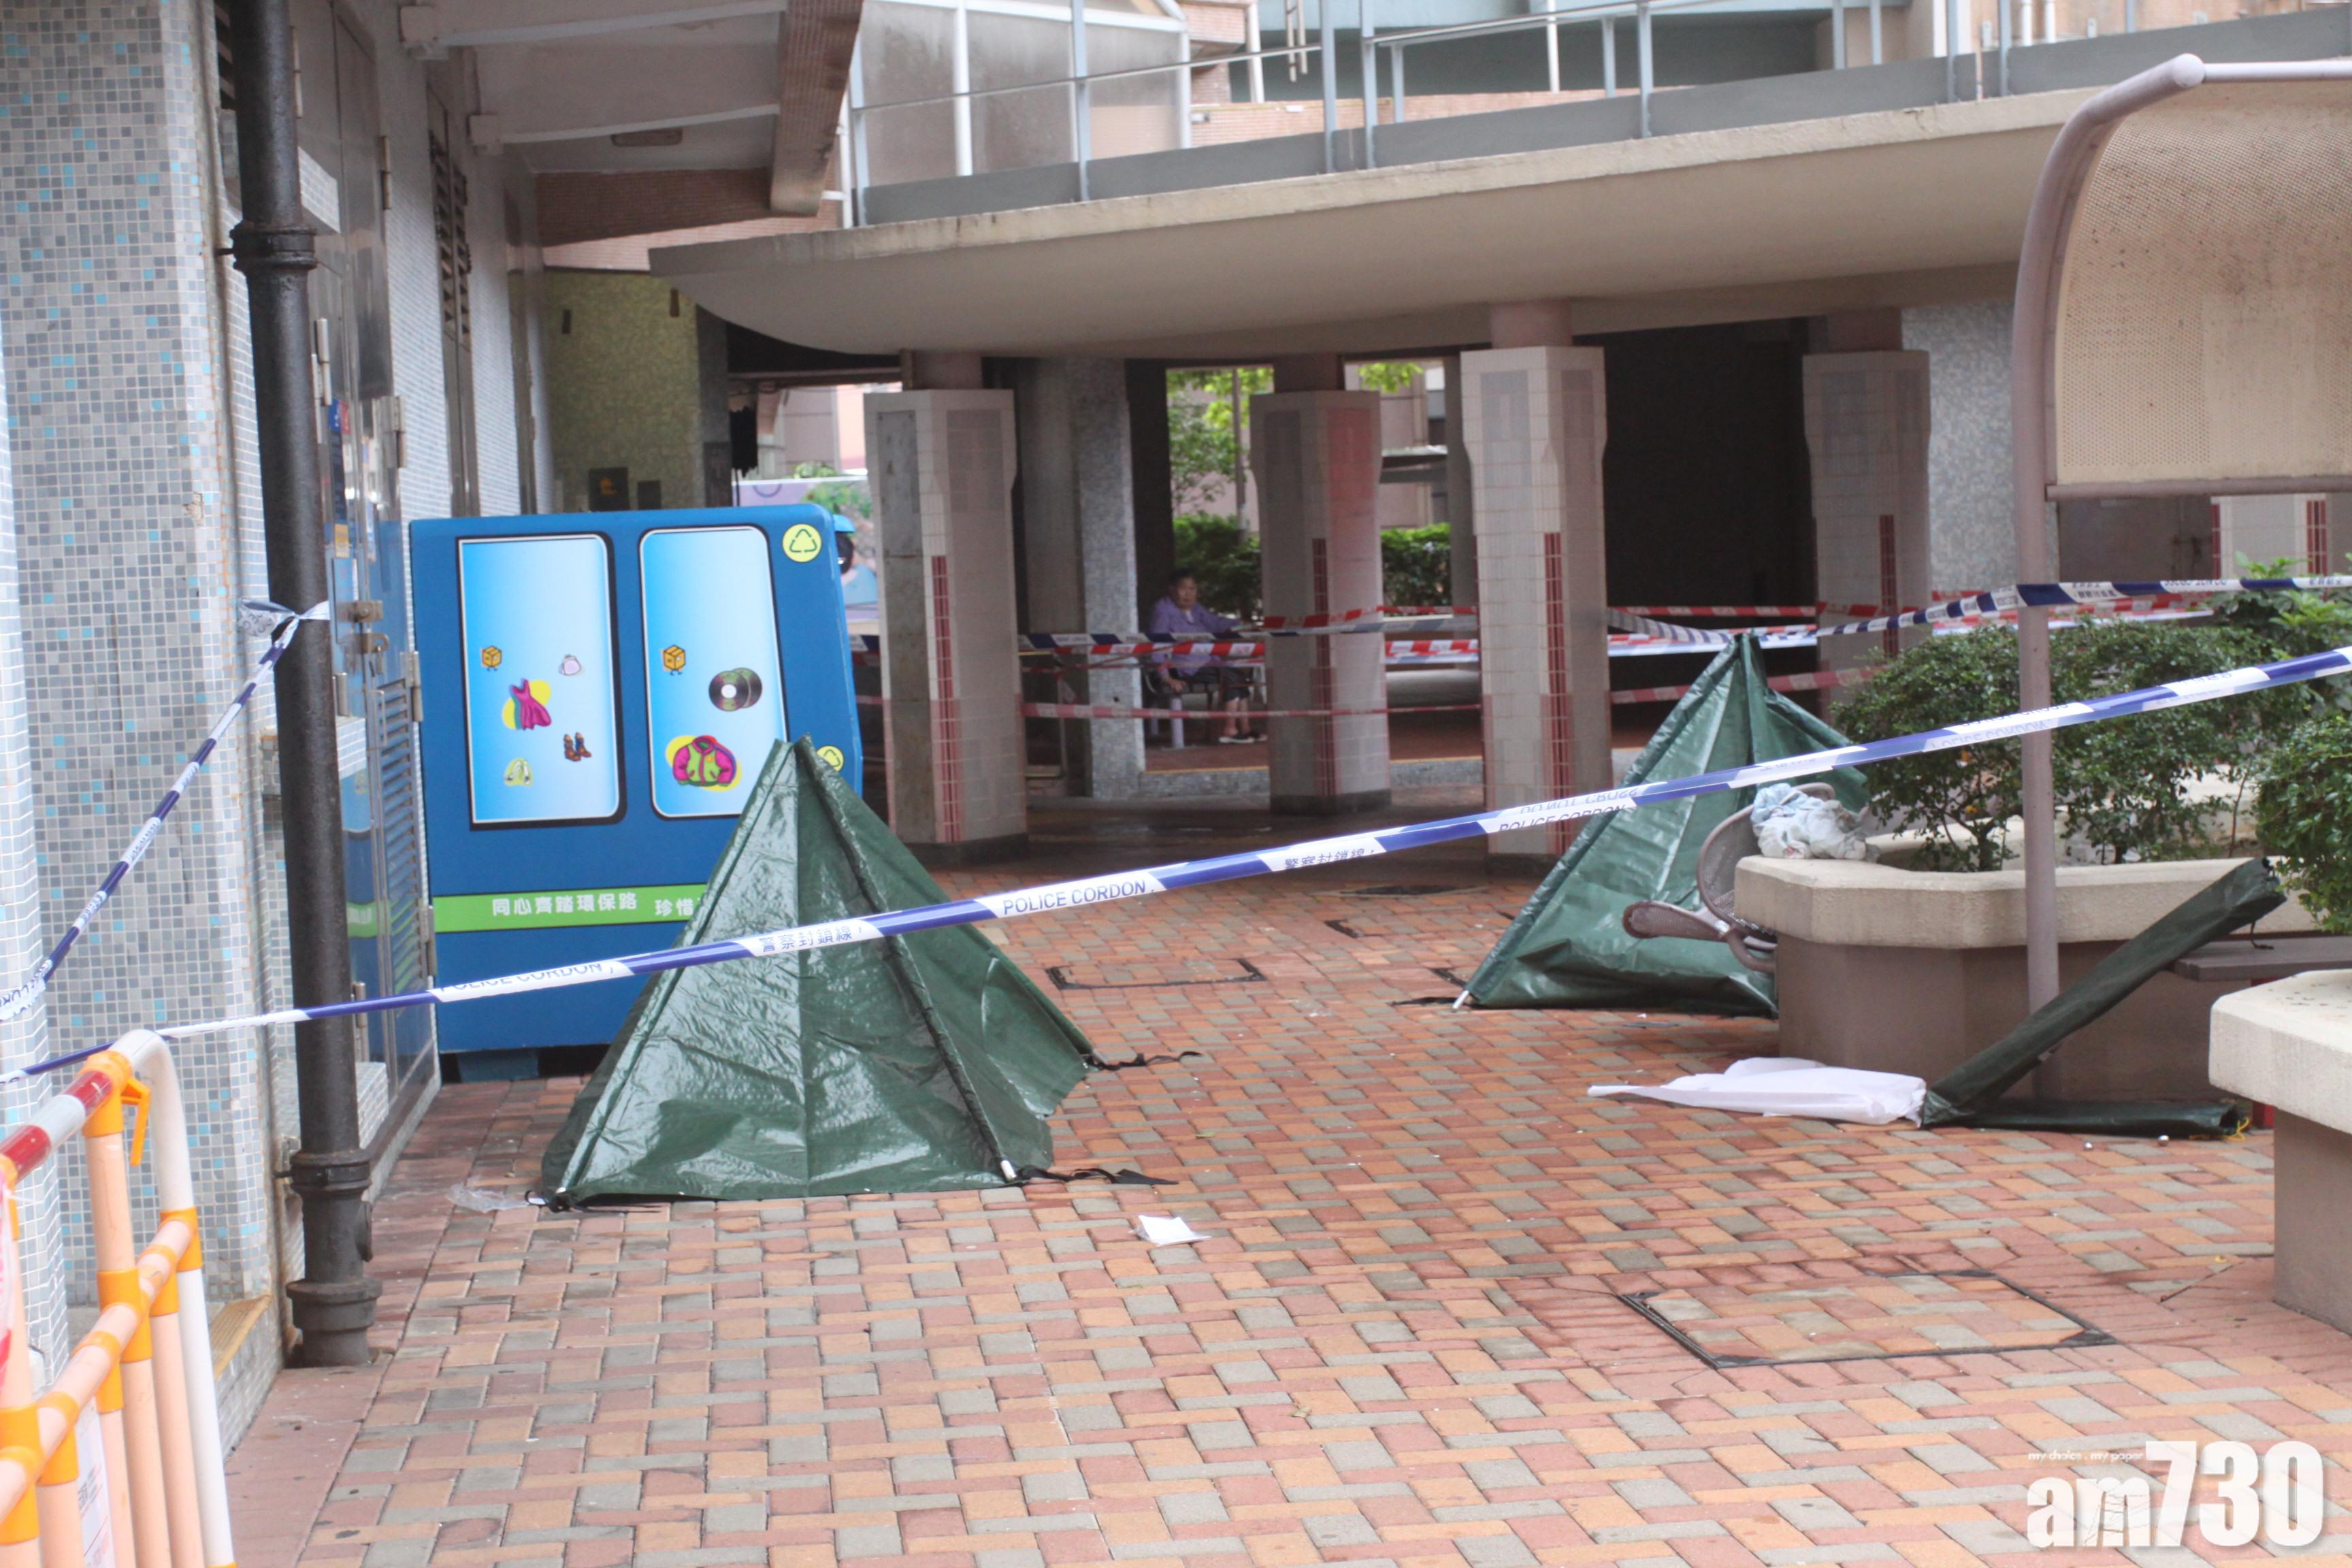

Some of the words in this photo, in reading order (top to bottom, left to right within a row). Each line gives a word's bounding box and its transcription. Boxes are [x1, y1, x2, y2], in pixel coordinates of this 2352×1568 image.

[491, 892, 638, 917] 同心齊踏環保路
[1002, 892, 1067, 915] POLICE
